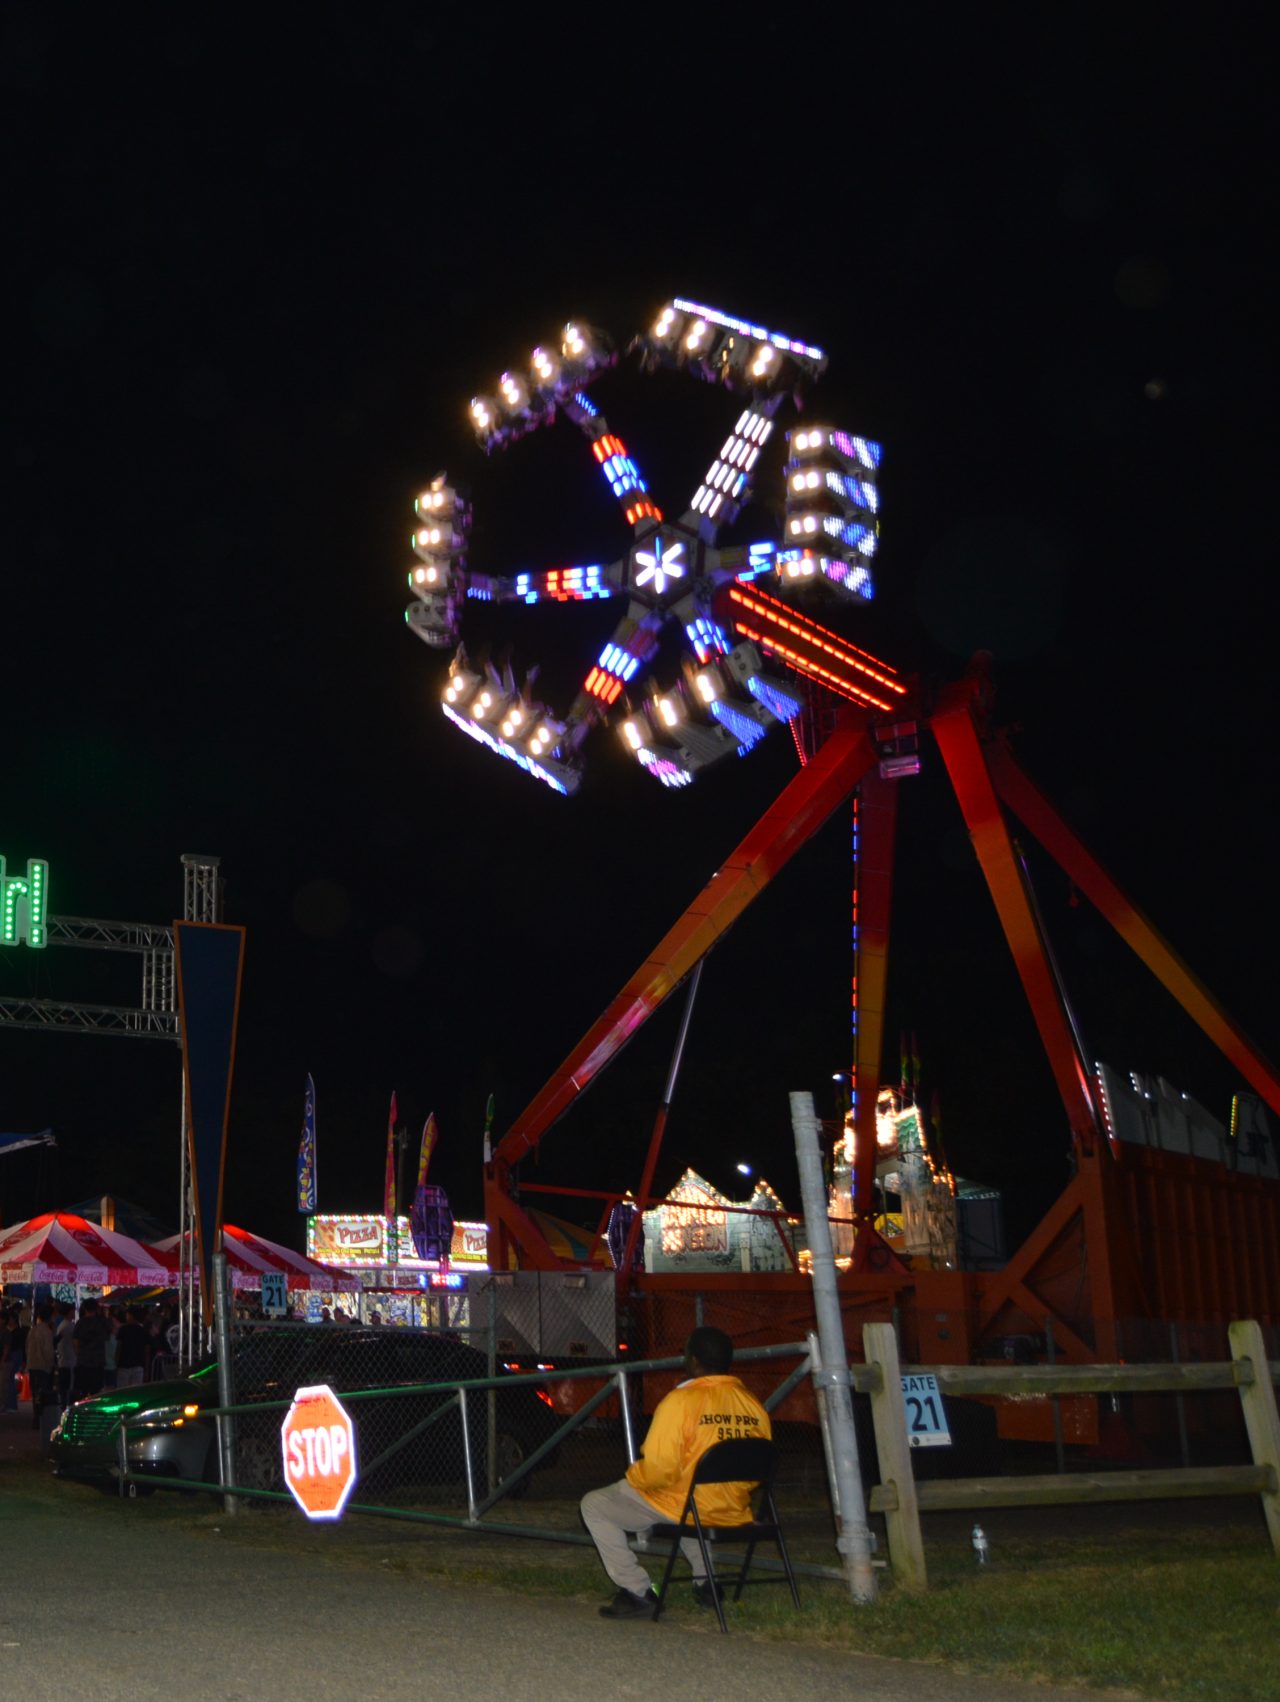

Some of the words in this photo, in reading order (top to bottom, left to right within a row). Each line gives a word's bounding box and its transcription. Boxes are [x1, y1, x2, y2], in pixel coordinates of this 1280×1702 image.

[336, 1226, 379, 1245] PIZZA
[262, 1274, 284, 1284] GATE
[265, 1286, 283, 1307] 21
[900, 1376, 936, 1393] GATE
[905, 1396, 941, 1432] 21
[289, 1424, 347, 1479] STOP
